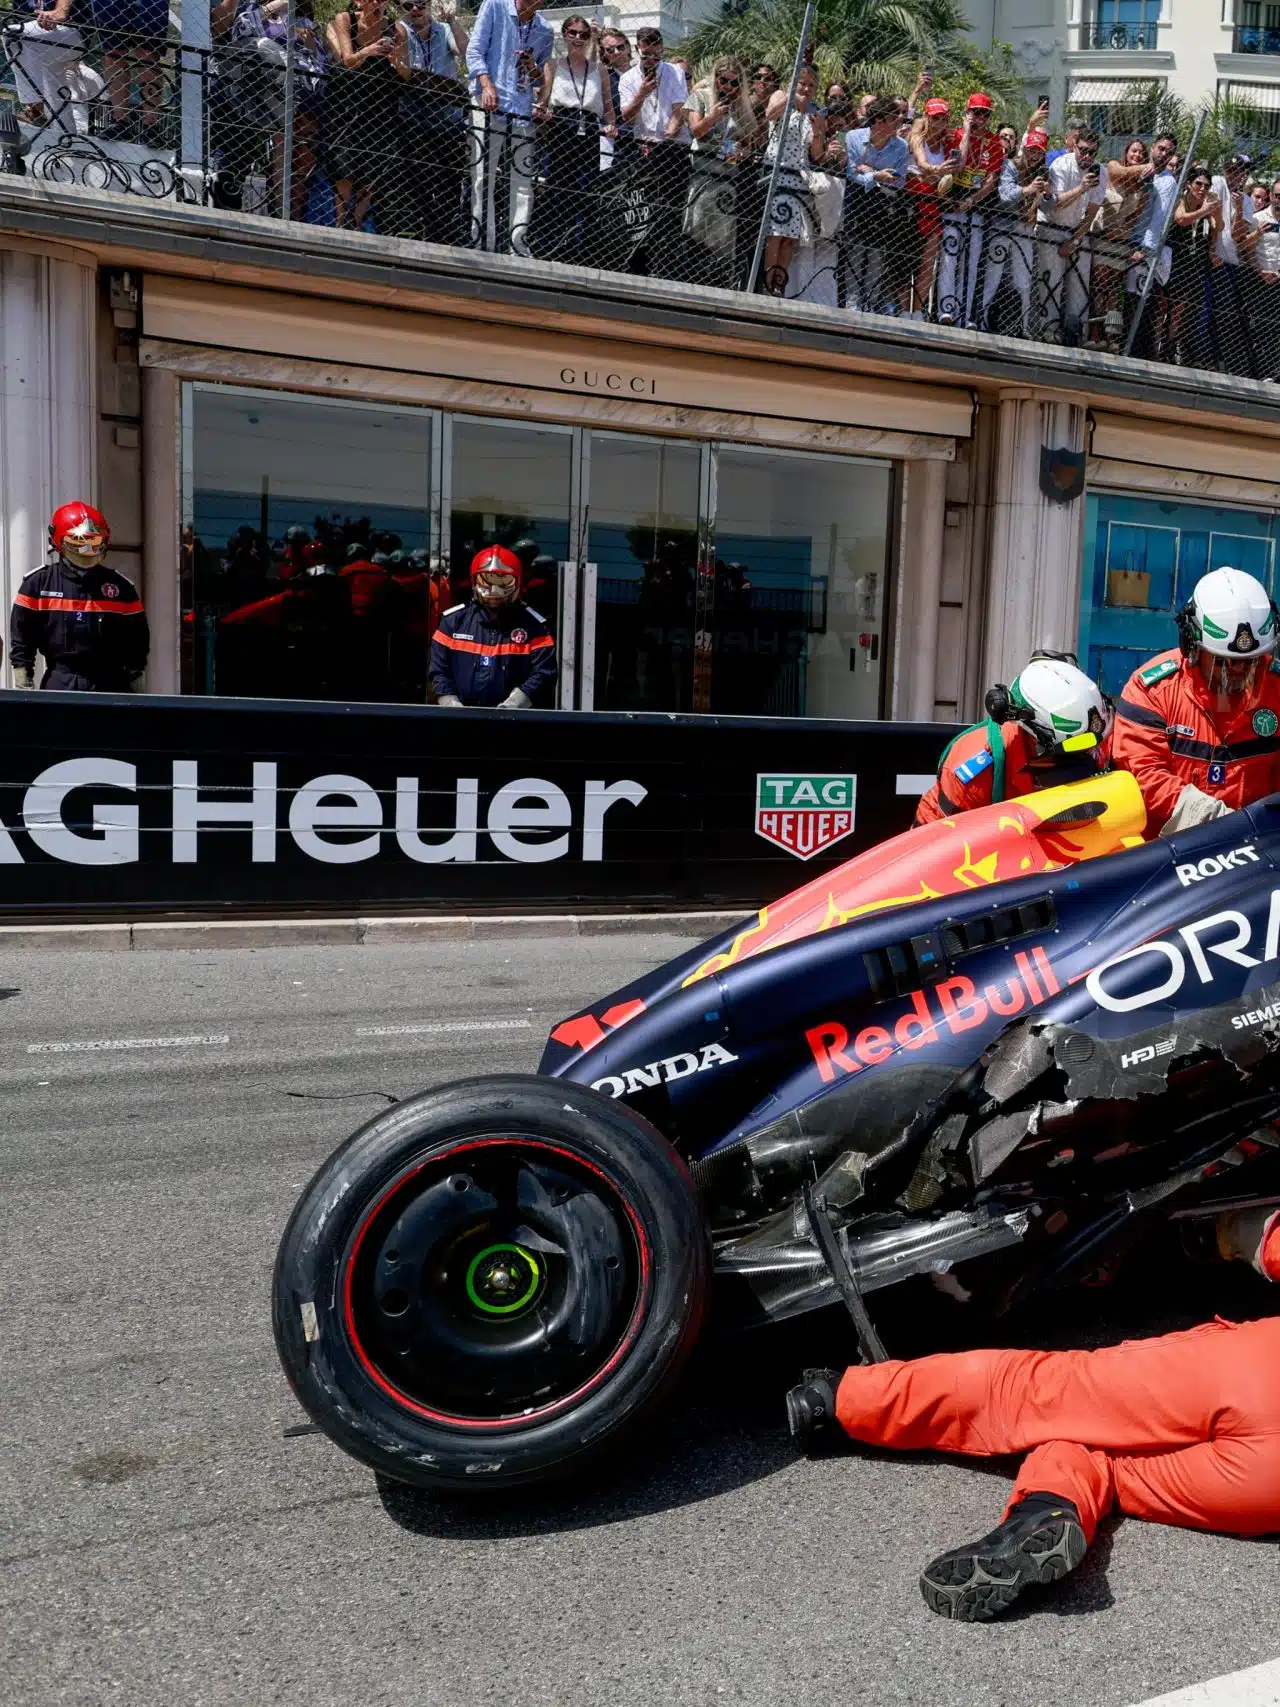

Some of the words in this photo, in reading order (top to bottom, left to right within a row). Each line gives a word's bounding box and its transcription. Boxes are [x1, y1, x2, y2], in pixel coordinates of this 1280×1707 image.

[560, 368, 656, 394] GUCCI
[76, 612, 82, 621] 2
[482, 656, 489, 666] 3
[1211, 766, 1221, 781] 3
[766, 780, 847, 805] TAG
[0, 757, 648, 864] GHeuer
[763, 814, 848, 853] HEUER
[1175, 845, 1261, 887] ROKT
[806, 988, 939, 1083] Red
[928, 946, 1061, 1034] Bull
[590, 1043, 739, 1099] ONDA
